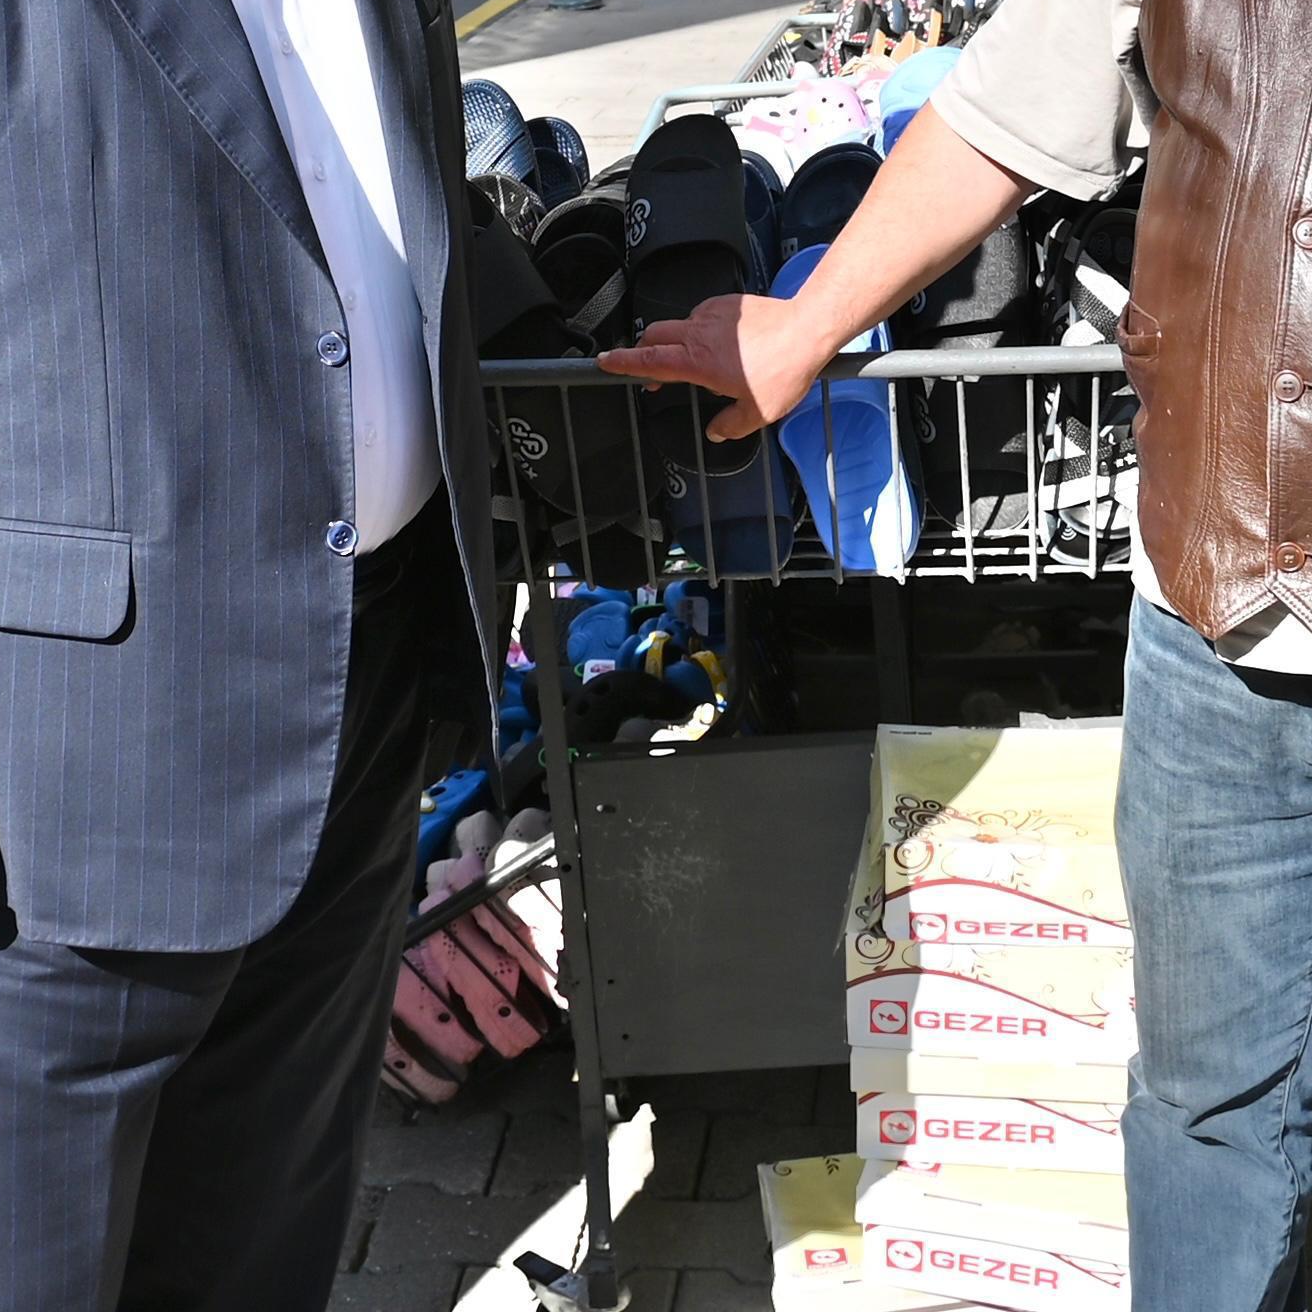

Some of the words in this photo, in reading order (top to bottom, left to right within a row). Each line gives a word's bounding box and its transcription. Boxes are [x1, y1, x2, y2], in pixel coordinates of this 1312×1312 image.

[954, 920, 1088, 942] GEZER
[913, 1010, 1047, 1037] GEZER
[924, 1118, 1055, 1144] GEZER
[929, 1249, 1059, 1290] GEZER
